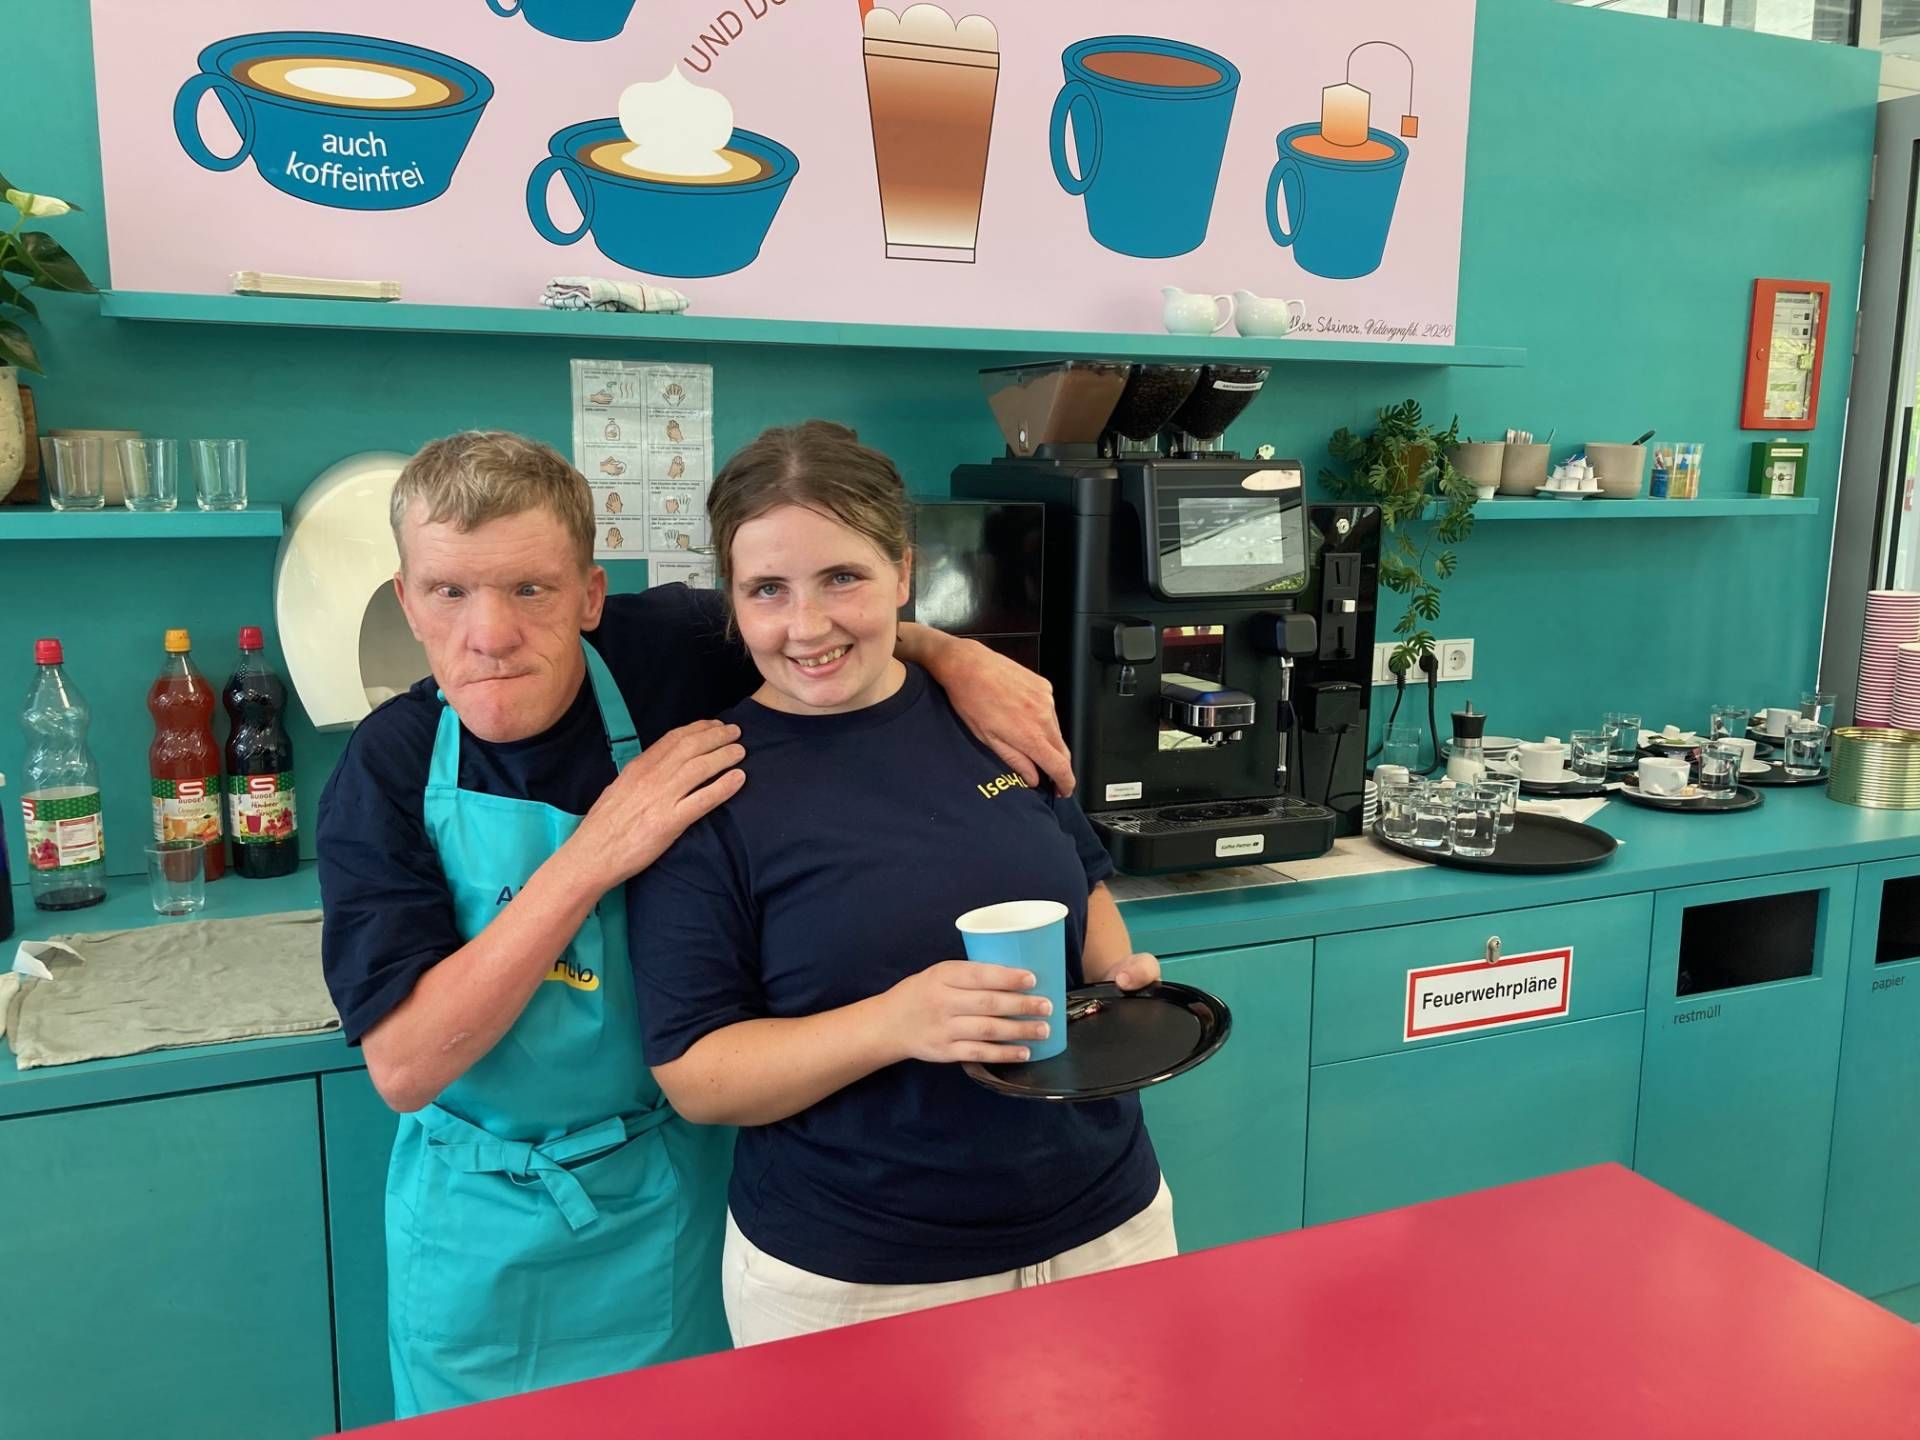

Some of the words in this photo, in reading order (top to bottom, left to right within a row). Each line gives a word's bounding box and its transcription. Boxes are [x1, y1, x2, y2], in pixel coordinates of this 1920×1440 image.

[683, 10, 743, 73] UND
[744, 0, 787, 20] D
[322, 131, 388, 158] auch
[285, 150, 425, 192] koffeinfrei
[1422, 976, 1558, 1010] Feuerwehrpläne
[1871, 974, 1907, 993] papier
[1672, 1004, 1722, 1025] restmüll
